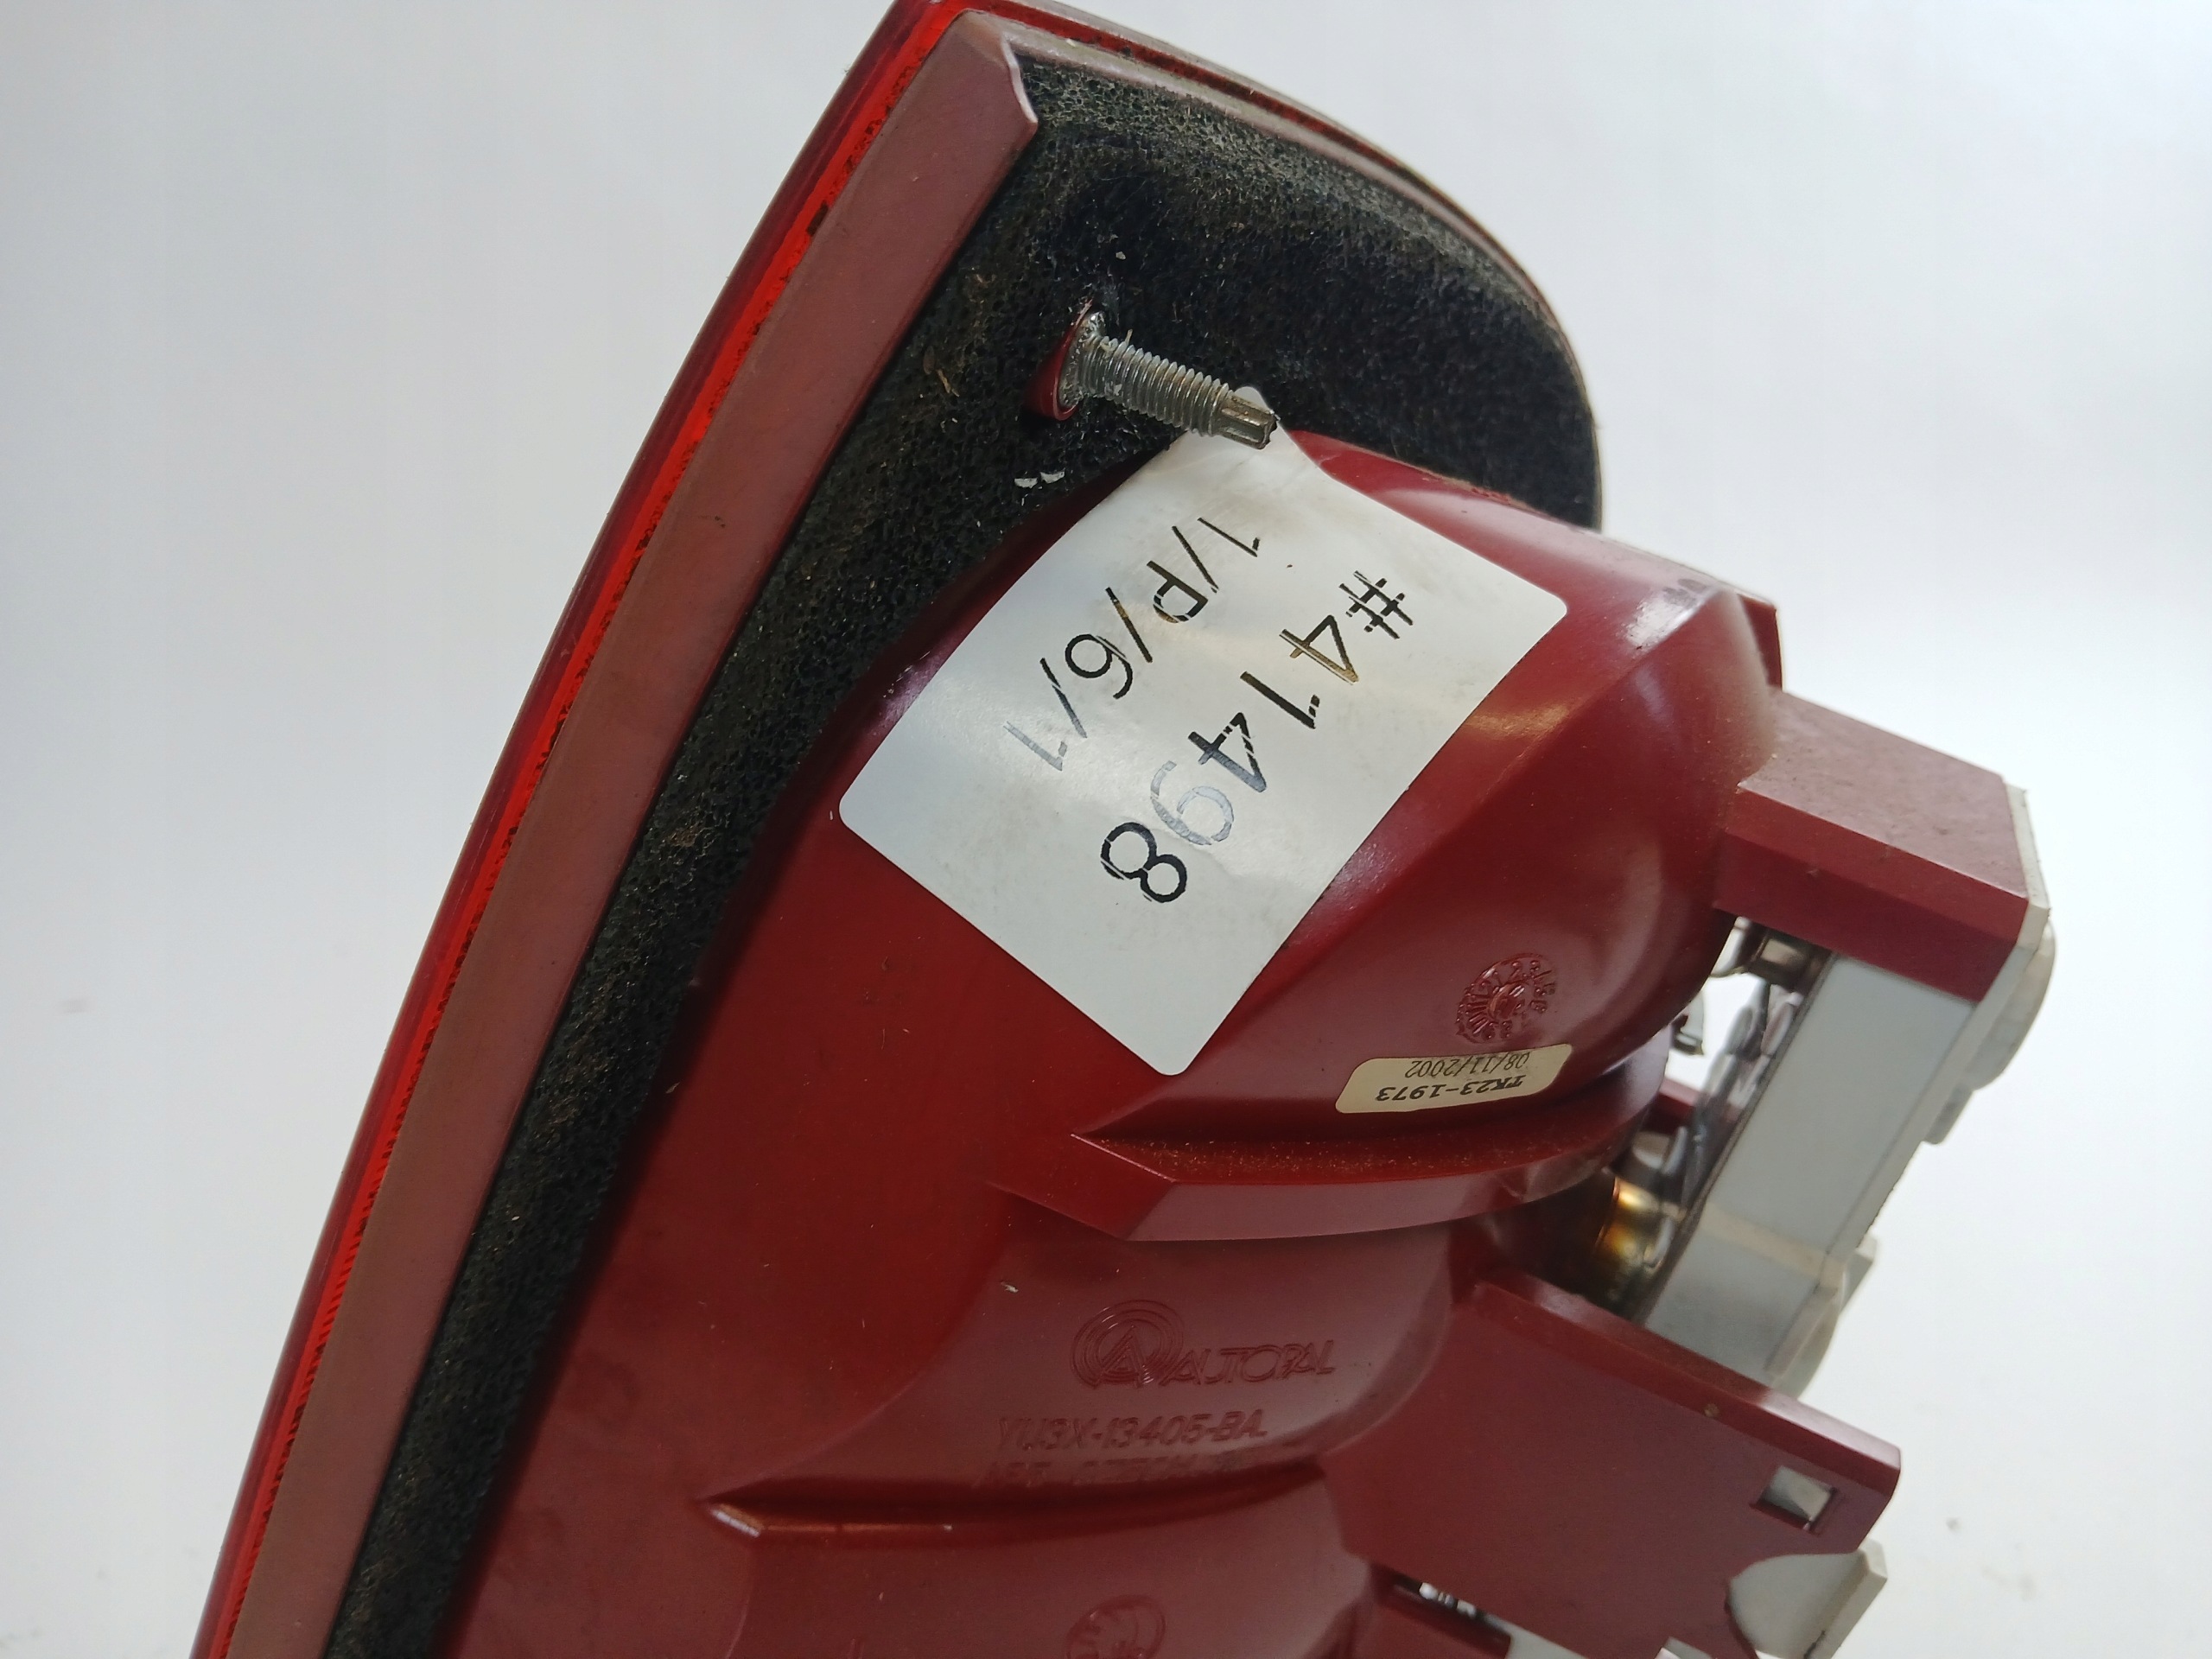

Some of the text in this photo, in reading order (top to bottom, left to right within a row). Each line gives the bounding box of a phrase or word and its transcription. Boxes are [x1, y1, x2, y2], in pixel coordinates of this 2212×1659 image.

[1003, 517, 1261, 772] 1/P/6/1
[1100, 571, 1414, 904] #41498
[1376, 1074, 1527, 1102] TK23-1973
[1404, 1051, 1530, 1078] 08/11/2002
[1157, 1339, 1336, 1388] AUTOPAL
